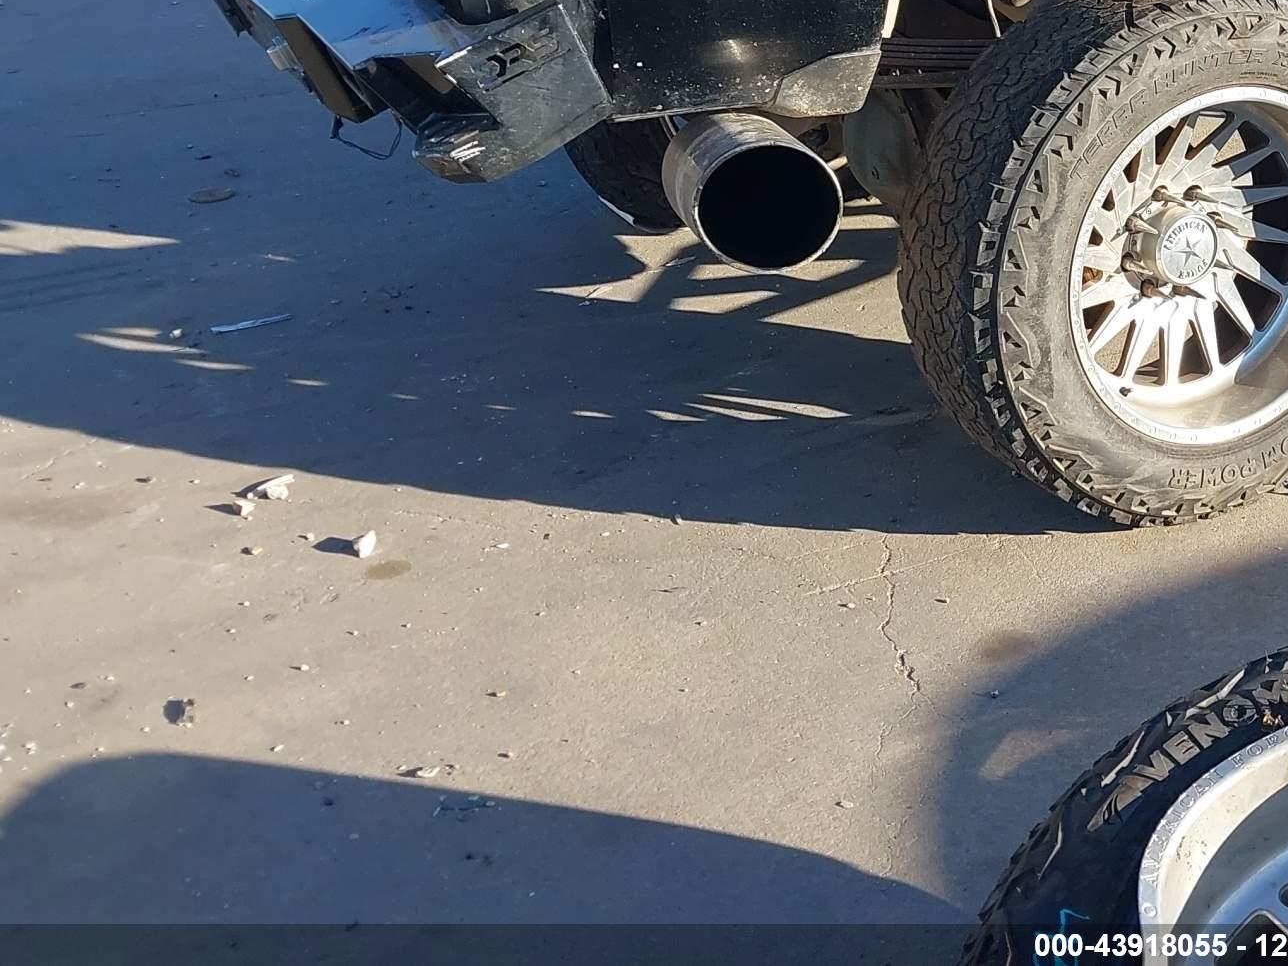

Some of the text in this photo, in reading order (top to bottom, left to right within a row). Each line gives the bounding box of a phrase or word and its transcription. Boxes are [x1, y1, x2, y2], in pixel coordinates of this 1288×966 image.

[1068, 88, 1147, 180] TERRA
[1153, 49, 1266, 95] HUNTER
[1168, 458, 1257, 490] POWER
[1142, 769, 1225, 885] AMERICAN
